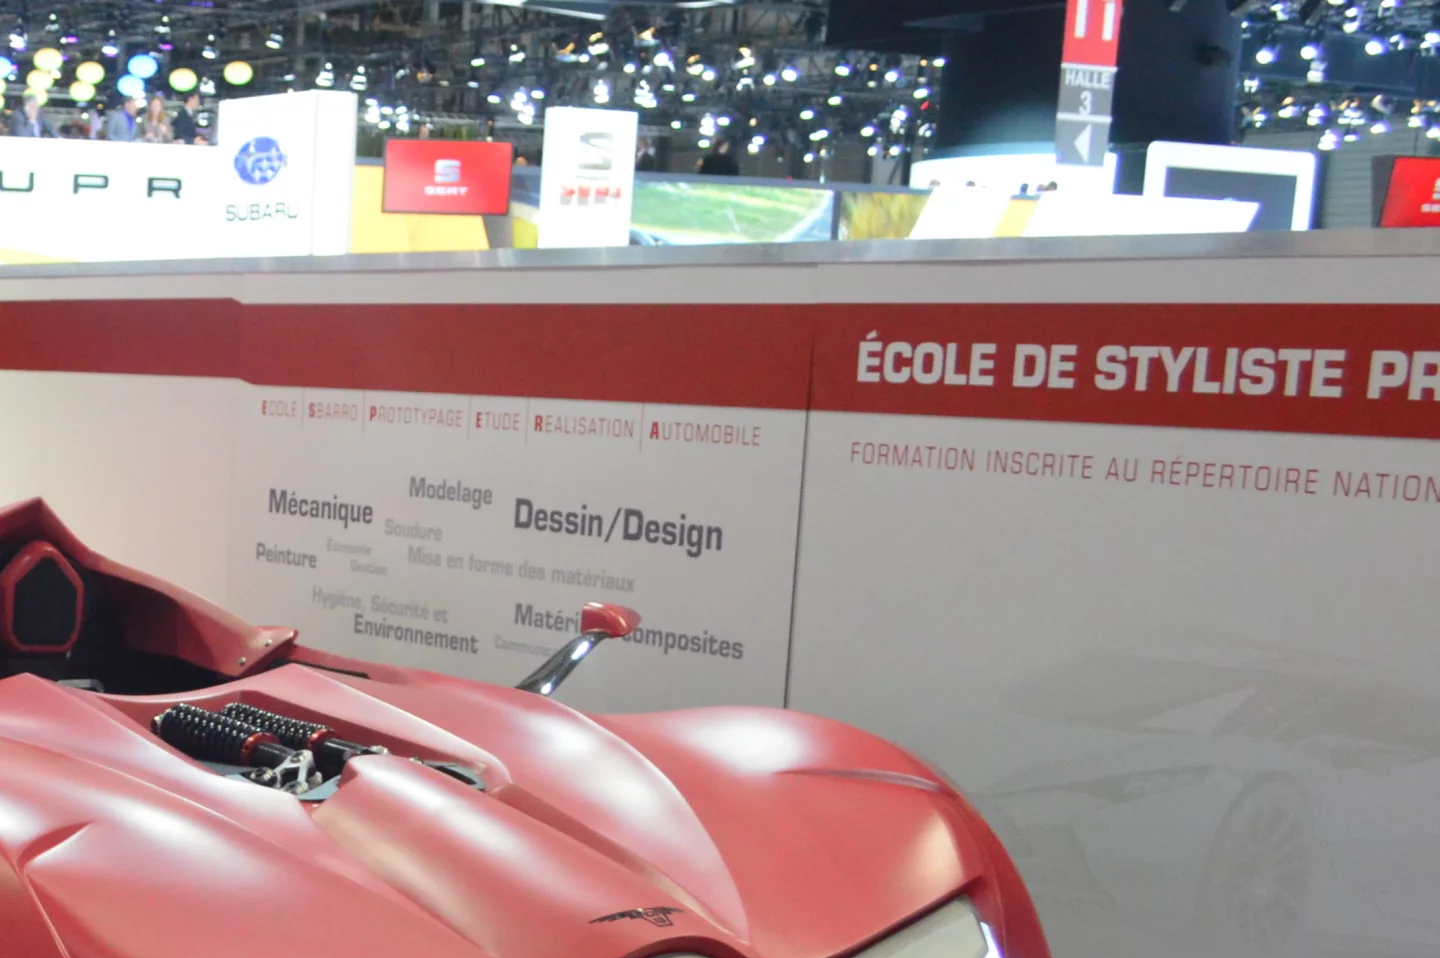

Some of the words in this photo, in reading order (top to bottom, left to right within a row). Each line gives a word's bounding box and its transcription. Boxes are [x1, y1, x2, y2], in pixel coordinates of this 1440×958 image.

[1065, 68, 1111, 90] HALLE
[1078, 89, 1092, 116] 3
[225, 201, 300, 222] SUBARU
[857, 330, 997, 387] ÉCOLE
[1012, 342, 1077, 390] DE
[1094, 345, 1346, 398] STYLISTE
[262, 400, 297, 417] ECOLE
[308, 402, 358, 421] SBARRO
[369, 405, 463, 428] PROTOTYPAGE
[476, 411, 521, 432] ETUDE
[534, 414, 635, 438] REALISATION
[650, 421, 762, 447] AUTOMOBILE
[850, 441, 975, 473] FORMATION
[986, 448, 1094, 480] INSCRITE
[1105, 457, 1138, 483] AU
[1151, 455, 1319, 495] RÉPERTOIRE
[269, 488, 373, 528] Mécanique
[410, 476, 493, 509] Modelage
[384, 518, 443, 542] Soudure
[514, 497, 723, 558] Dessin/Design
[256, 542, 317, 568] Peinture
[408, 545, 442, 567] Mise
[446, 553, 464, 570] en
[469, 553, 513, 576] forme
[518, 560, 545, 580] des
[551, 568, 636, 593] matériaux
[353, 613, 479, 655] Environnement
[514, 602, 580, 635] Matéri
